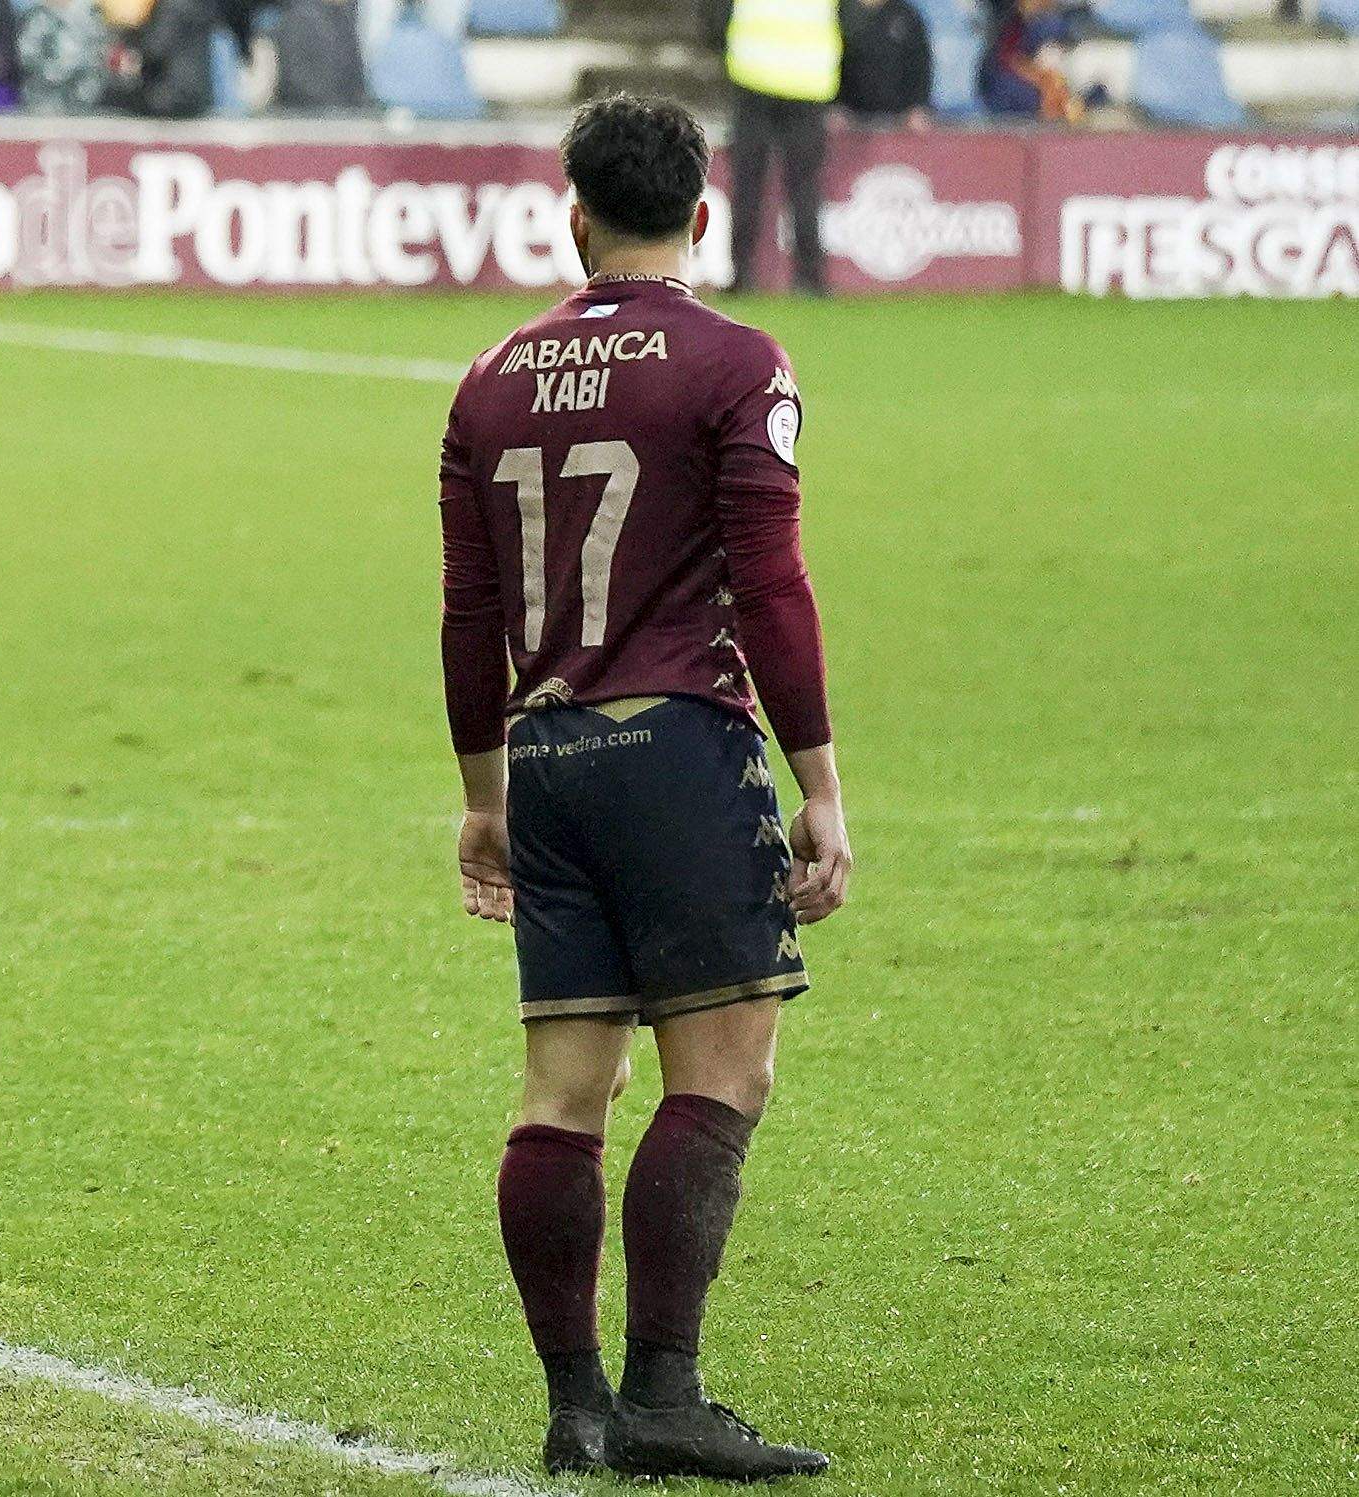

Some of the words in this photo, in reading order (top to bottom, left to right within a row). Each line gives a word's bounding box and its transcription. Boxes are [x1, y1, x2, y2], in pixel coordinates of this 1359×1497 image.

[12, 140, 142, 285] de
[530, 367, 611, 414] XABI
[492, 440, 641, 653] 17
